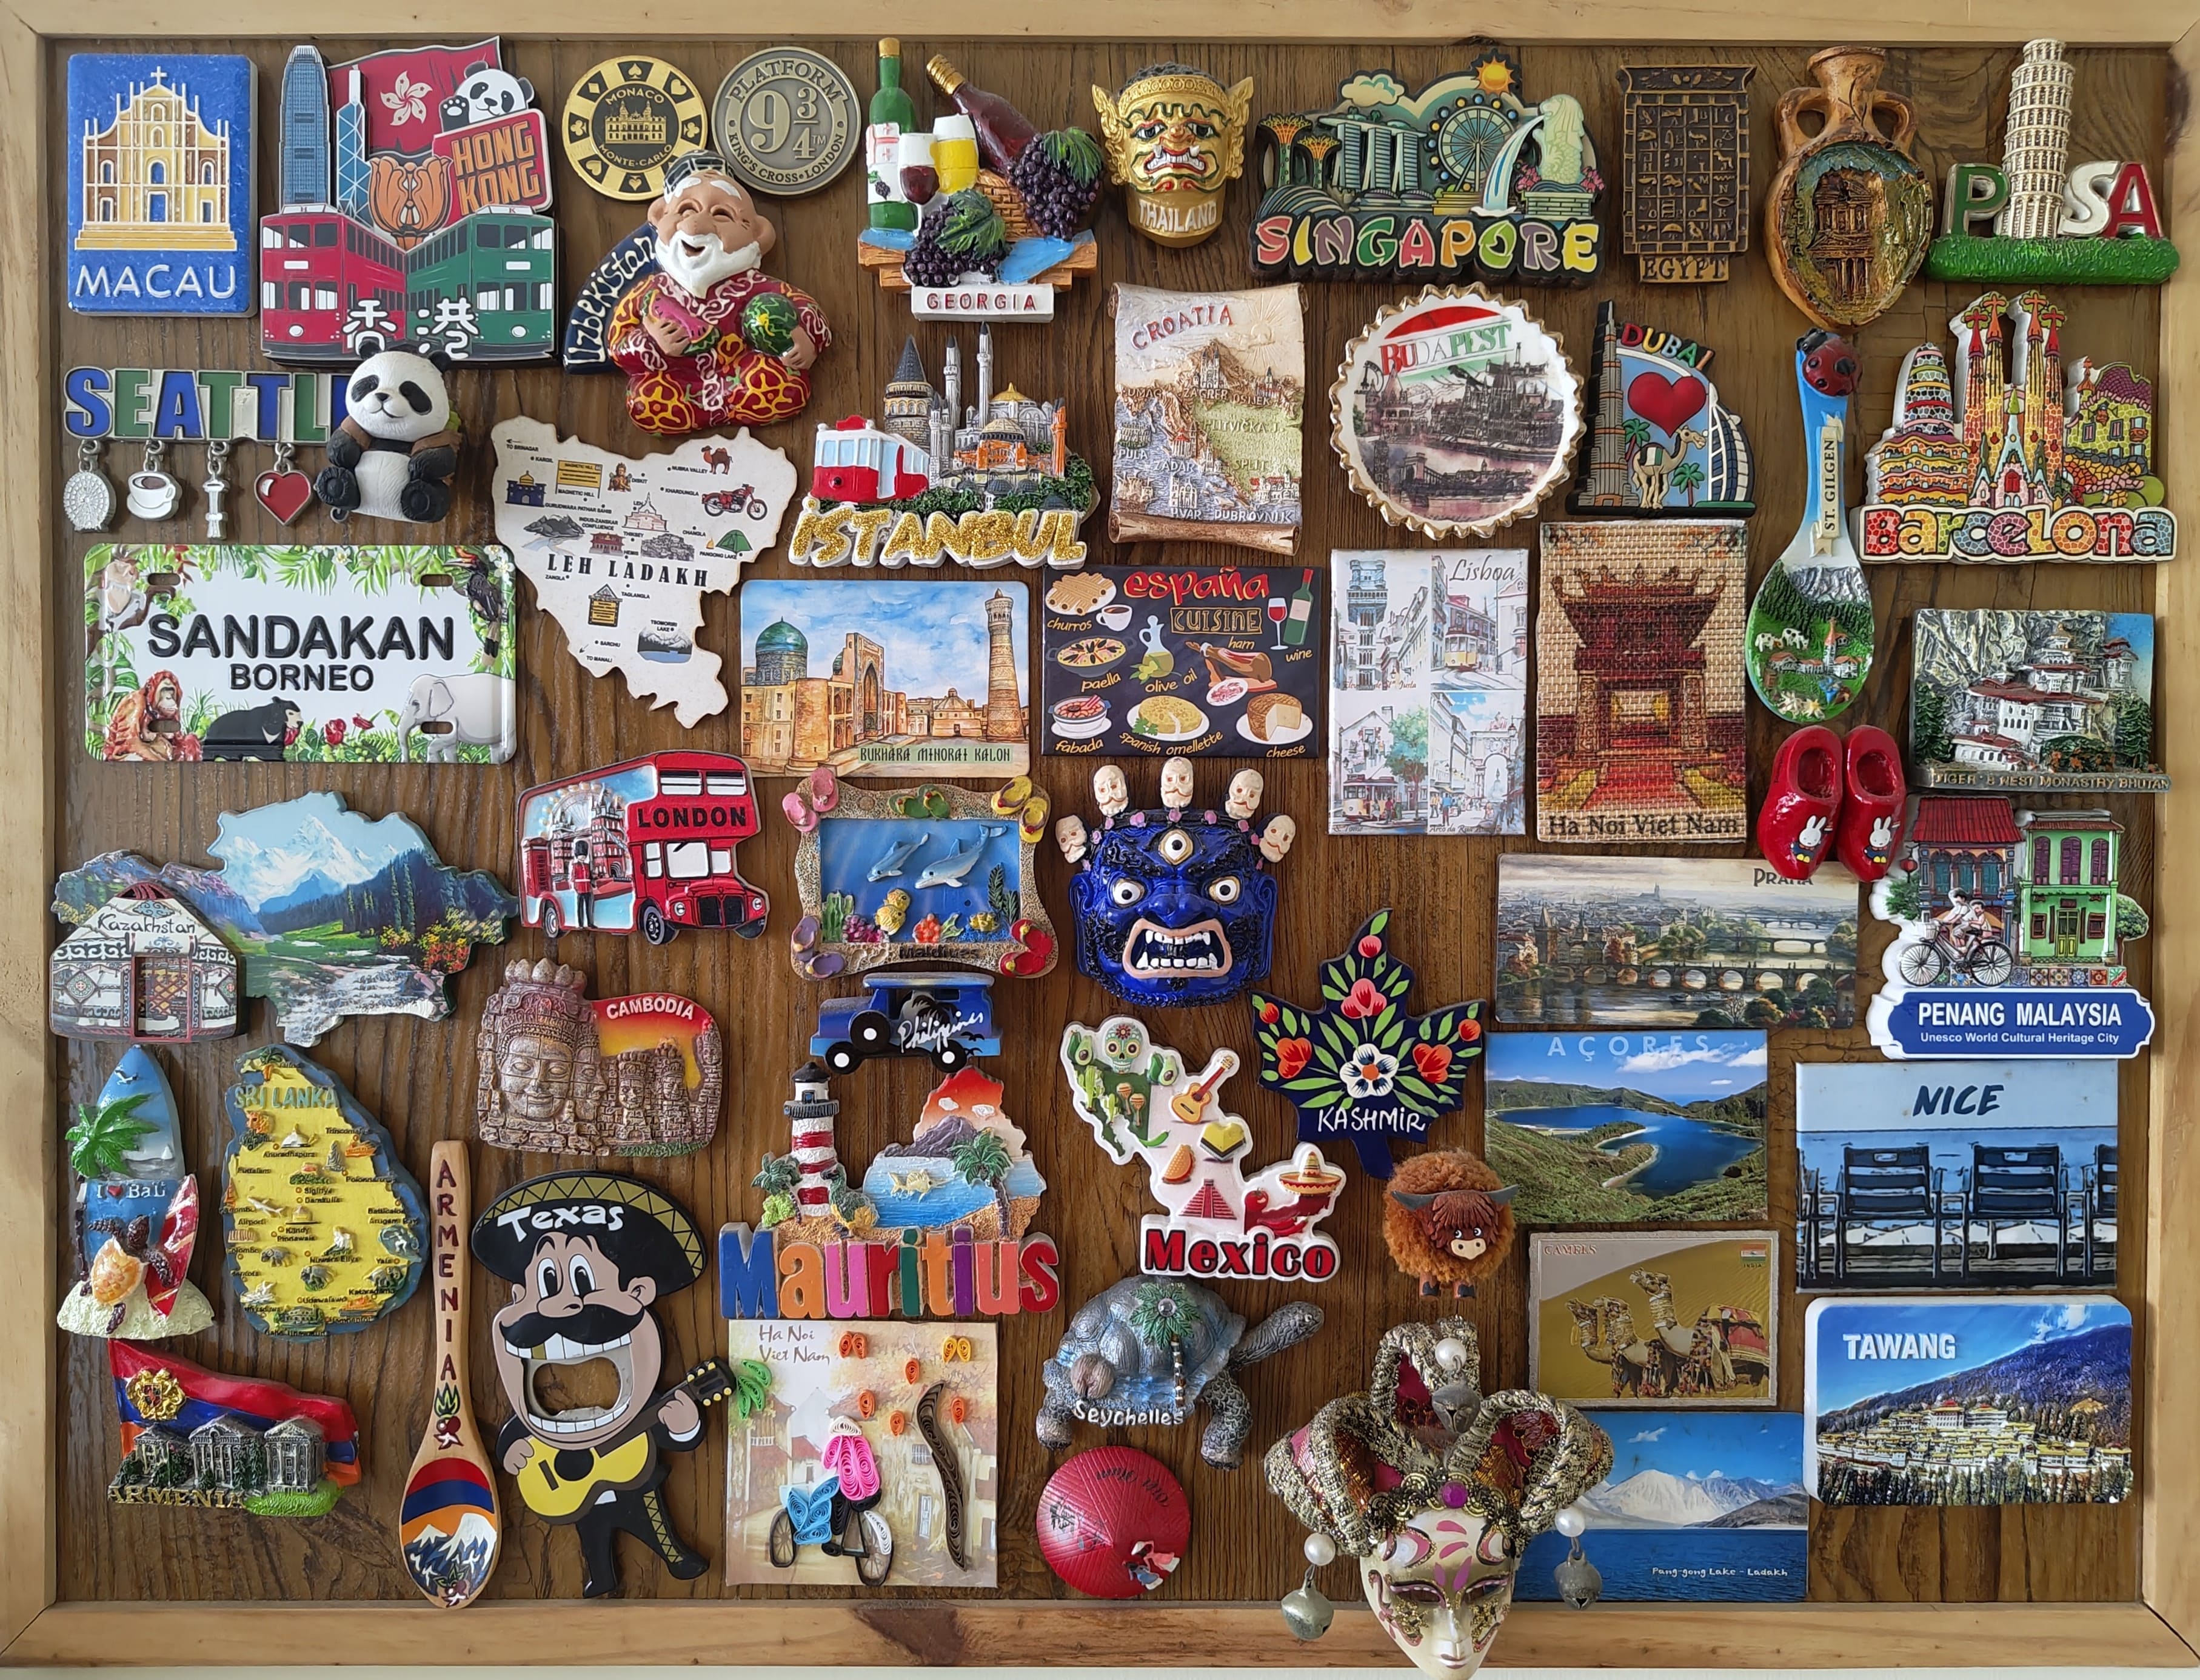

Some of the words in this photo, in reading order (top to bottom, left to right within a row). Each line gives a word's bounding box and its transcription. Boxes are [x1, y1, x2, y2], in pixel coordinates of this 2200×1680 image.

[729, 59, 846, 104] PLATFORM
[606, 87, 665, 105] MONACO
[451, 121, 533, 176] HONG
[812, 135, 827, 145] TM
[728, 132, 756, 172] KING'S
[758, 168, 798, 183] CROSS
[805, 133, 845, 179] LONDON
[457, 160, 541, 216] KONG
[1138, 200, 1217, 233] THAILAND
[1255, 215, 1599, 272] SINGAPORE
[75, 264, 236, 298] MACAU
[1642, 257, 1727, 281] EGYPT
[926, 292, 1037, 311] GEORGIA
[343, 297, 479, 360] 香港
[1131, 304, 1234, 350] CROATIA
[1379, 323, 1512, 376] BUDAPEST
[1620, 322, 1715, 371] DUBAI
[1183, 388, 1228, 399] ZAGREB
[1232, 395, 1269, 405] OSIJEK
[1119, 449, 1148, 460] PULA
[1153, 461, 1194, 472] ZADAR
[1234, 460, 1267, 471] SPLIT
[1824, 438, 1837, 503] GILGEN
[1172, 509, 1202, 519] HVAR
[1215, 509, 1294, 523] DUBROVNIK
[1824, 506, 1837, 531] ST.
[547, 553, 592, 575] LEH
[607, 560, 708, 587] LADAKH
[1449, 555, 1516, 582] Lisboa
[1123, 566, 1269, 605] españa
[147, 613, 454, 661] SANDAKAN
[1047, 617, 1092, 634] churros
[1228, 636, 1255, 650] ham
[1285, 648, 1313, 662] wine
[229, 664, 375, 692] BORNEO
[1081, 673, 1122, 692] paella
[1145, 679, 1178, 693] olive
[1183, 668, 1198, 684] oil
[1399, 680, 1417, 690] Justa
[860, 747, 911, 762] BUKHARA
[974, 747, 1011, 762] KALON
[1055, 738, 1104, 754] fabada
[1118, 732, 1160, 755] spanish
[1166, 730, 1223, 755] omellette
[1266, 745, 1306, 758] cheese
[2119, 778, 2170, 789] BHUTAN
[638, 807, 747, 828] LONDON
[1549, 816, 1578, 836] Ha
[1585, 816, 1626, 835] Noi
[1629, 816, 1679, 835] Viet
[1687, 815, 1739, 835] Nam
[97, 912, 196, 935] Kazakhstan
[899, 945, 980, 959] Maldives
[606, 998, 694, 1020] CAMBODIA
[1919, 1002, 2005, 1026] PENANG
[2016, 1002, 2122, 1026] MALAYSIA
[898, 1011, 984, 1053] Philippines
[1921, 1032, 1962, 1042] Unesco
[1965, 1032, 1998, 1042] World
[2001, 1032, 2045, 1042] Cultural
[2048, 1033, 2094, 1045] Heritage
[2098, 1033, 2119, 1045] City
[1548, 1035, 1709, 1062] AÇORES
[234, 1084, 267, 1109] SRI
[272, 1085, 339, 1109] LANKA
[1913, 1084, 2004, 1116] NICE
[96, 1184, 102, 1198] I
[498, 1205, 624, 1242] Texas
[1145, 1228, 1335, 1278] Mexico
[1543, 1244, 1597, 1256] CAMELS
[436, 1159, 461, 1381] ARMENIA
[720, 1224, 1059, 1319] Mauritius
[759, 1325, 782, 1342] Ha
[788, 1325, 814, 1341] Noi
[759, 1345, 789, 1362] Viet
[793, 1345, 830, 1364] Nam
[1842, 1333, 1956, 1359] TAWANG
[1073, 1400, 1185, 1427] Seychelles
[108, 1487, 244, 1508] ARMENIA
[1653, 1567, 1706, 1578] Pang-gong
[1747, 1568, 1788, 1576] Ladakh
